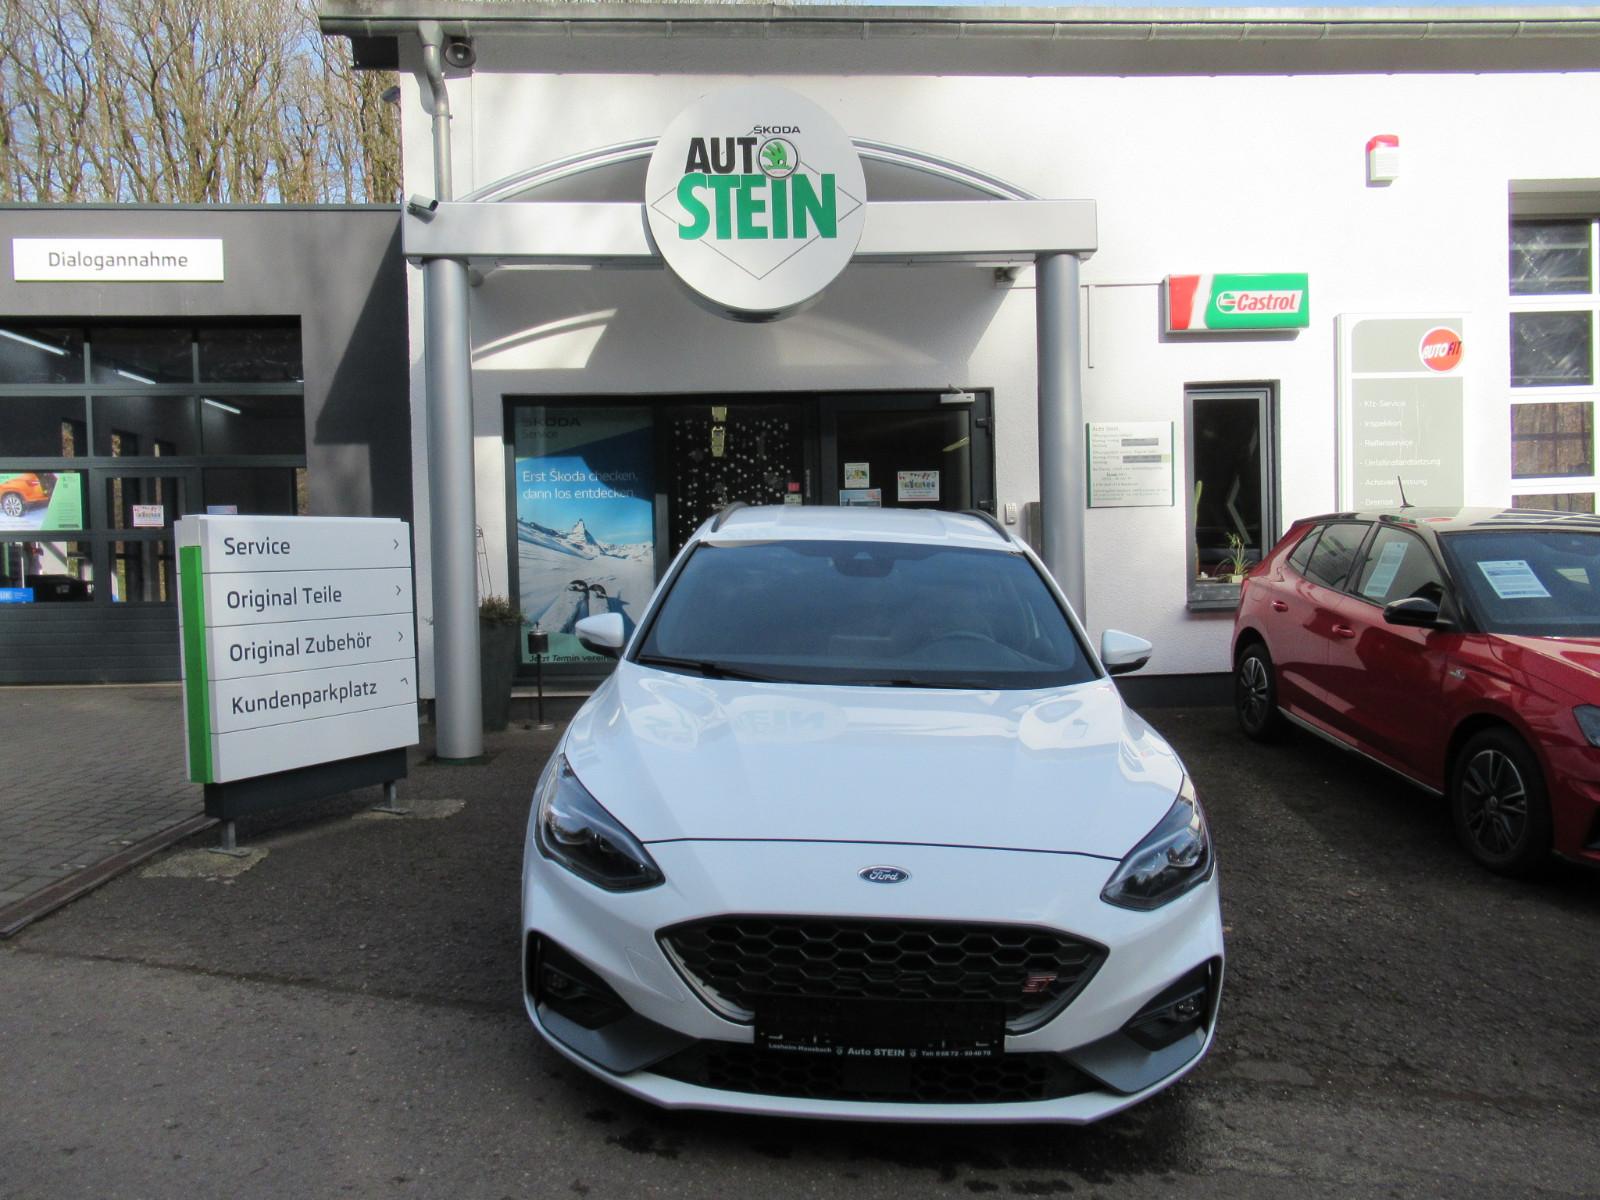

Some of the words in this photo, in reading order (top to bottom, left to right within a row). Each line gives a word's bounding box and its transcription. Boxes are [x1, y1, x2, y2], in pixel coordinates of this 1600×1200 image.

[753, 124, 801, 134] ŠKODA
[676, 172, 838, 240] STEIN
[48, 251, 188, 271] Dialogannahme
[1237, 293, 1296, 311] Castrol
[522, 470, 546, 482] Erst
[549, 467, 586, 482] Škoda
[522, 487, 552, 499] dann
[554, 487, 572, 499] los
[224, 536, 291, 556] Service
[227, 587, 297, 612] Original
[302, 585, 342, 605] Teile
[230, 637, 300, 664] Original
[305, 631, 372, 654] Zubehör
[232, 680, 377, 715] Kundenparkplatz
[847, 1047, 871, 1056] Auto
[873, 1048, 905, 1057] STEIN
